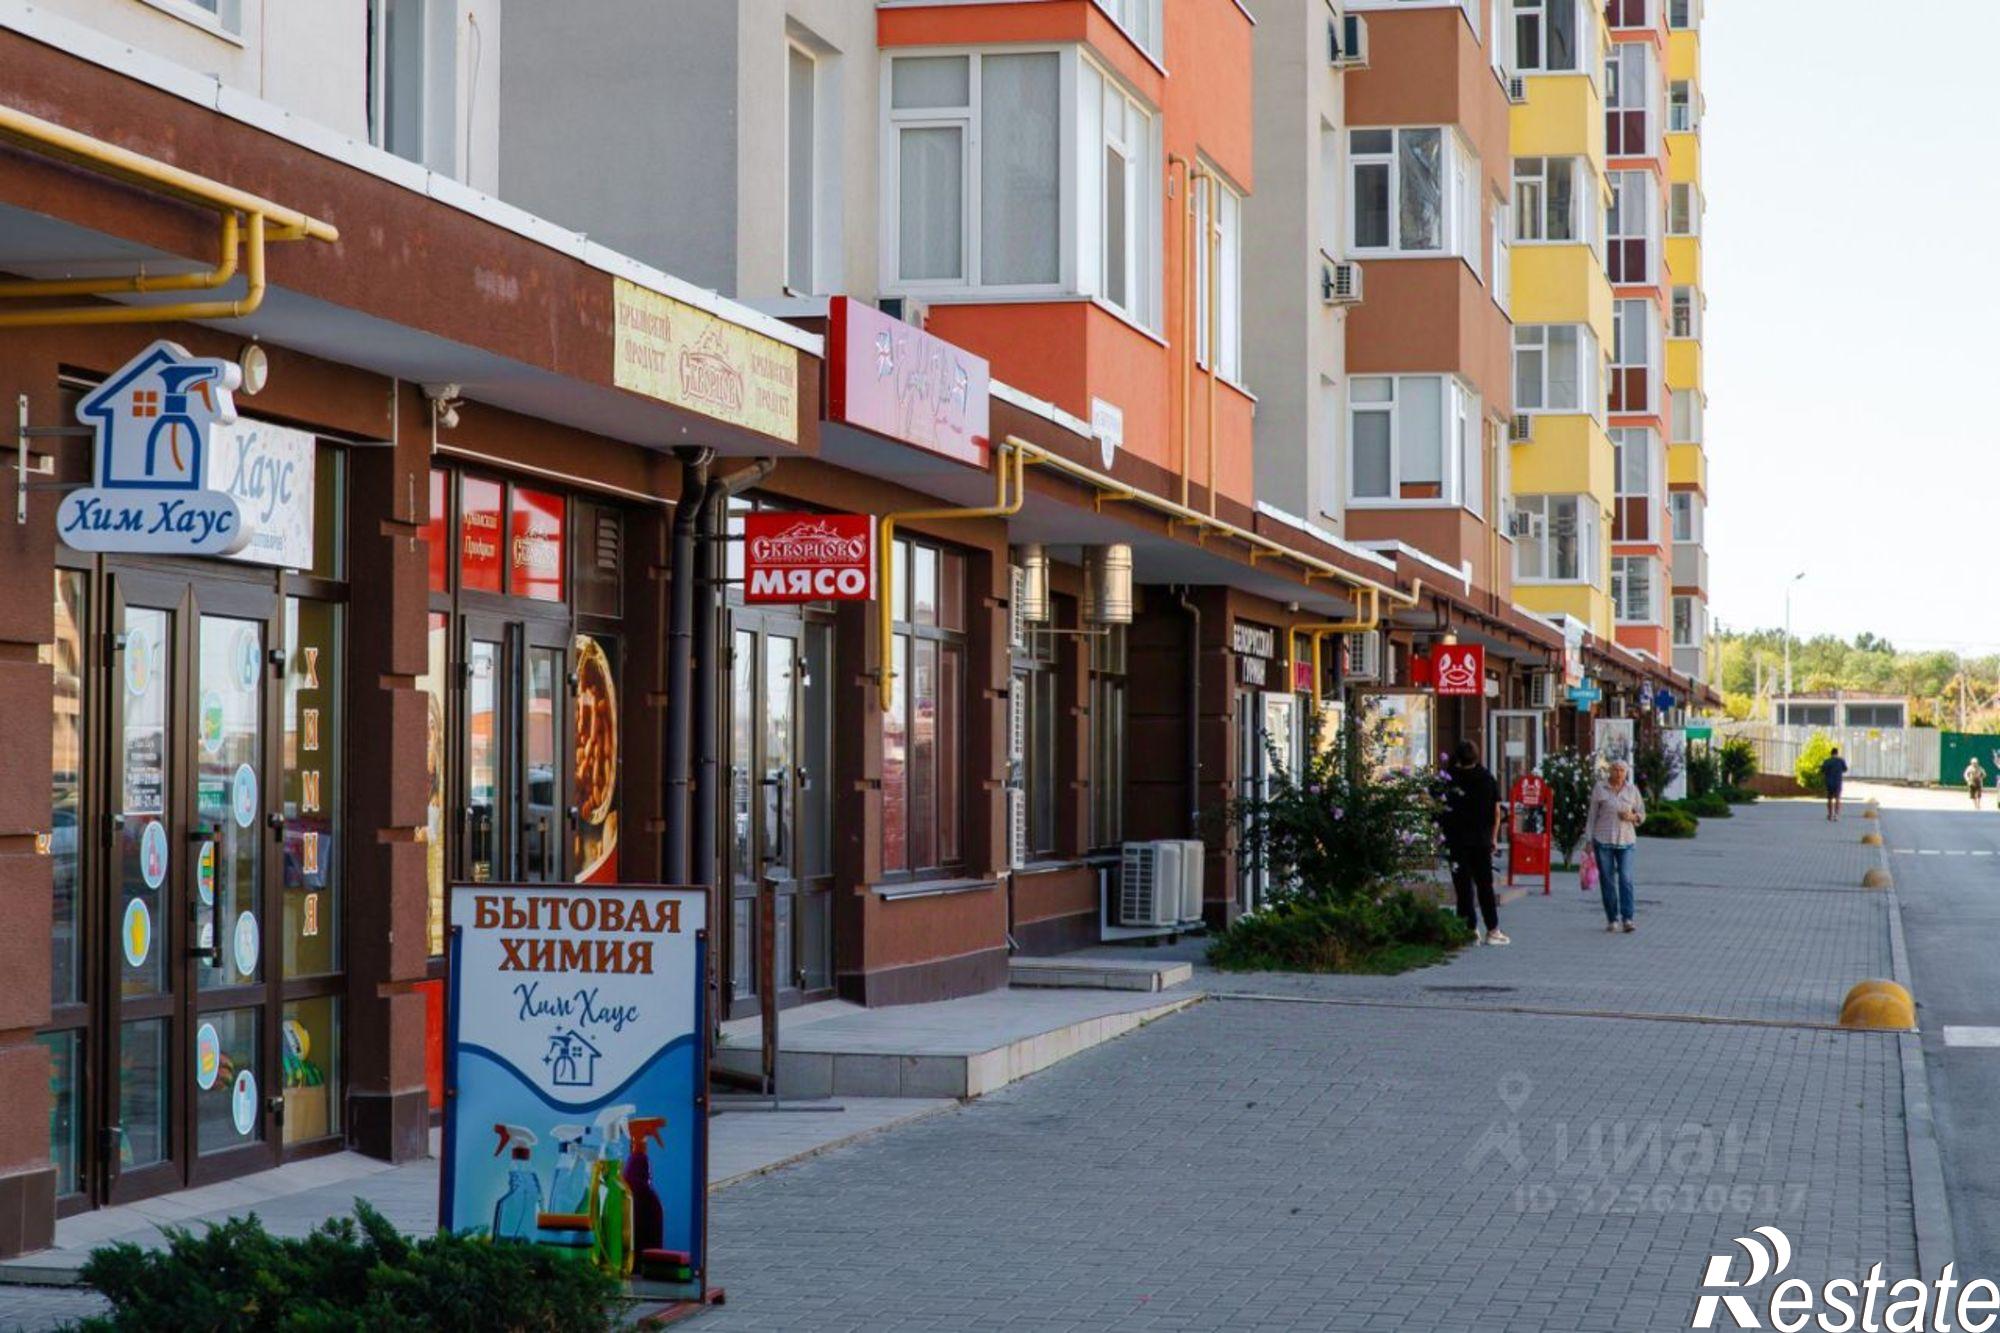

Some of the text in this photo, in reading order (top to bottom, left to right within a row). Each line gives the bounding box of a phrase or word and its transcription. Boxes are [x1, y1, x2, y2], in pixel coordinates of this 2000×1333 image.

[227, 432, 294, 523] Хаус
[65, 498, 143, 532] Хим
[148, 500, 233, 544] Хаус
[750, 567, 866, 595] МЯСО
[474, 896, 682, 933] БЫТОВАЯ
[498, 938, 654, 975] ХИМИЯ
[513, 981, 640, 1032] Хим Хаус
